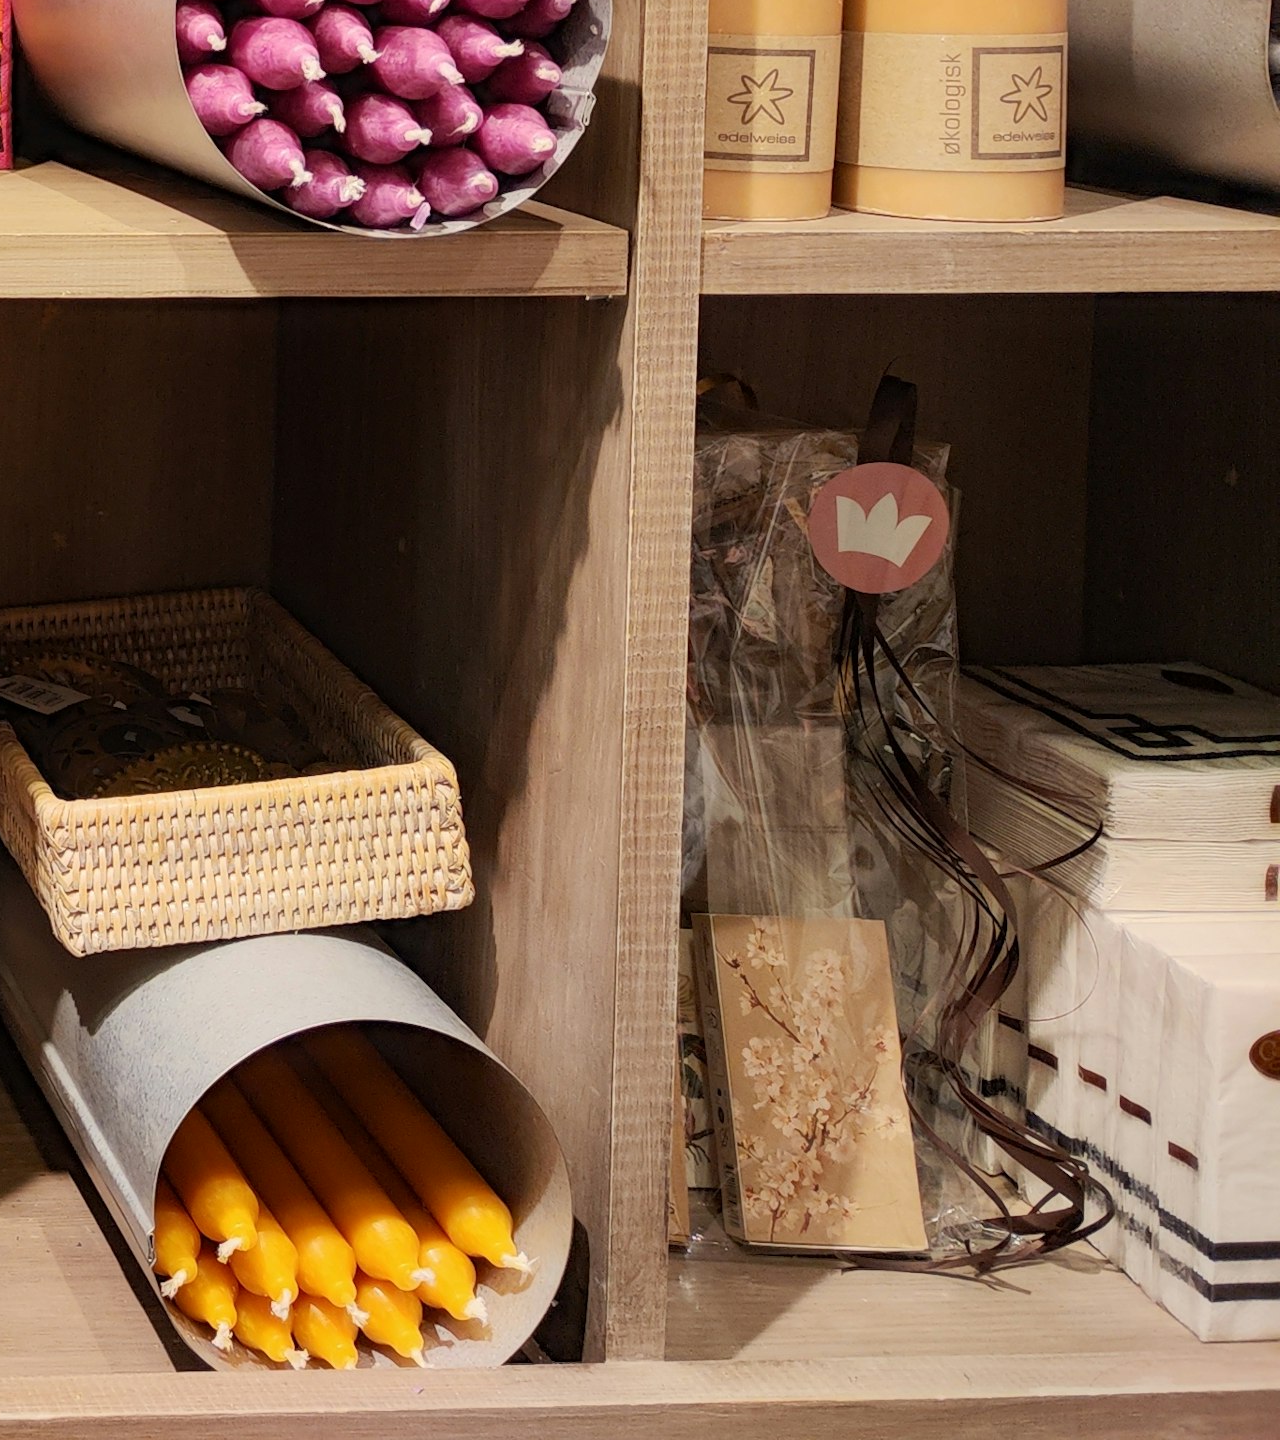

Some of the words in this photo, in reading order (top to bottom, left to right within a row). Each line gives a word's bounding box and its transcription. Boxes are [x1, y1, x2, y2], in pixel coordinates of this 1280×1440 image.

[939, 51, 967, 155] økologisk
[717, 131, 796, 145] edelweiss
[992, 130, 1055, 142] edelweiss
